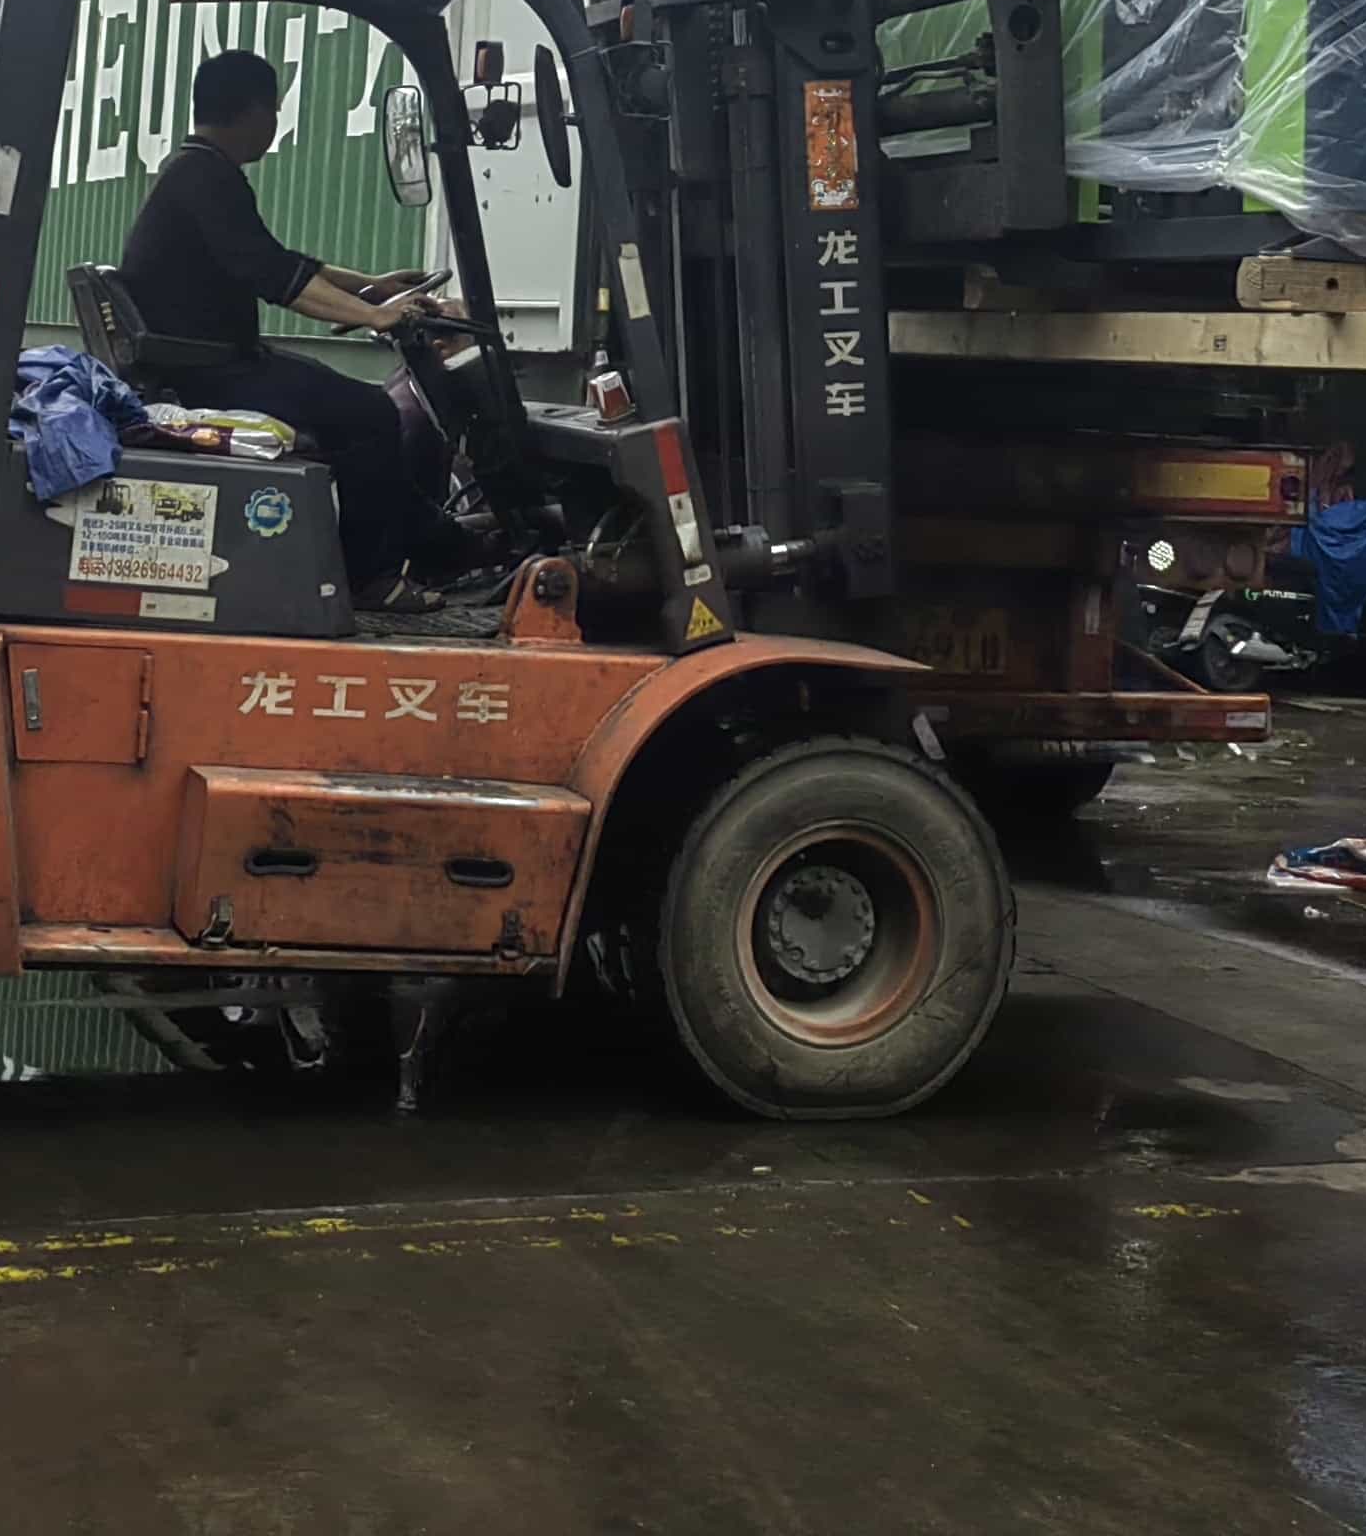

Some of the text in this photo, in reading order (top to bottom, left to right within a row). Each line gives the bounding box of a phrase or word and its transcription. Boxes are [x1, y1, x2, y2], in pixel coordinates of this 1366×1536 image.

[817, 229, 866, 417] 龙工叉车
[238, 671, 511, 723] 龙工叉车
